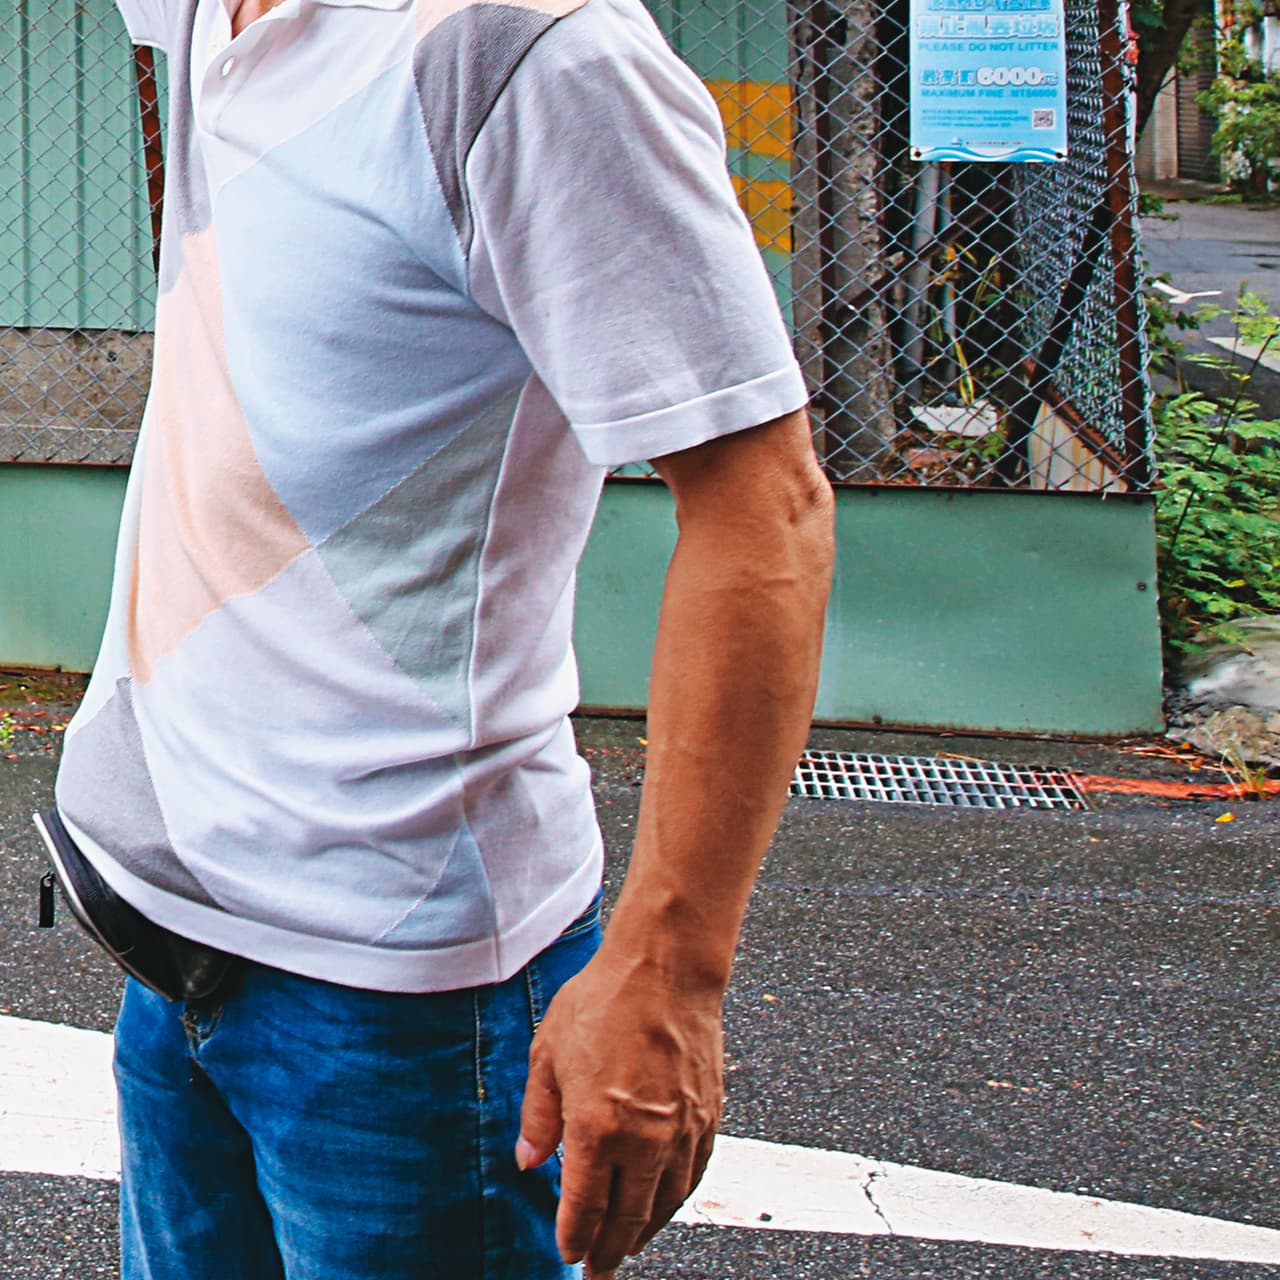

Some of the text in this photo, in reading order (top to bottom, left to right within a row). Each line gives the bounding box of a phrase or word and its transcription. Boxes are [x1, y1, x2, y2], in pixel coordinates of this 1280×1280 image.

[918, 42, 1059, 52] PLEASE DO NOT LITTER
[921, 89, 976, 97] MAXIMUM
[978, 89, 1004, 98] FINE
